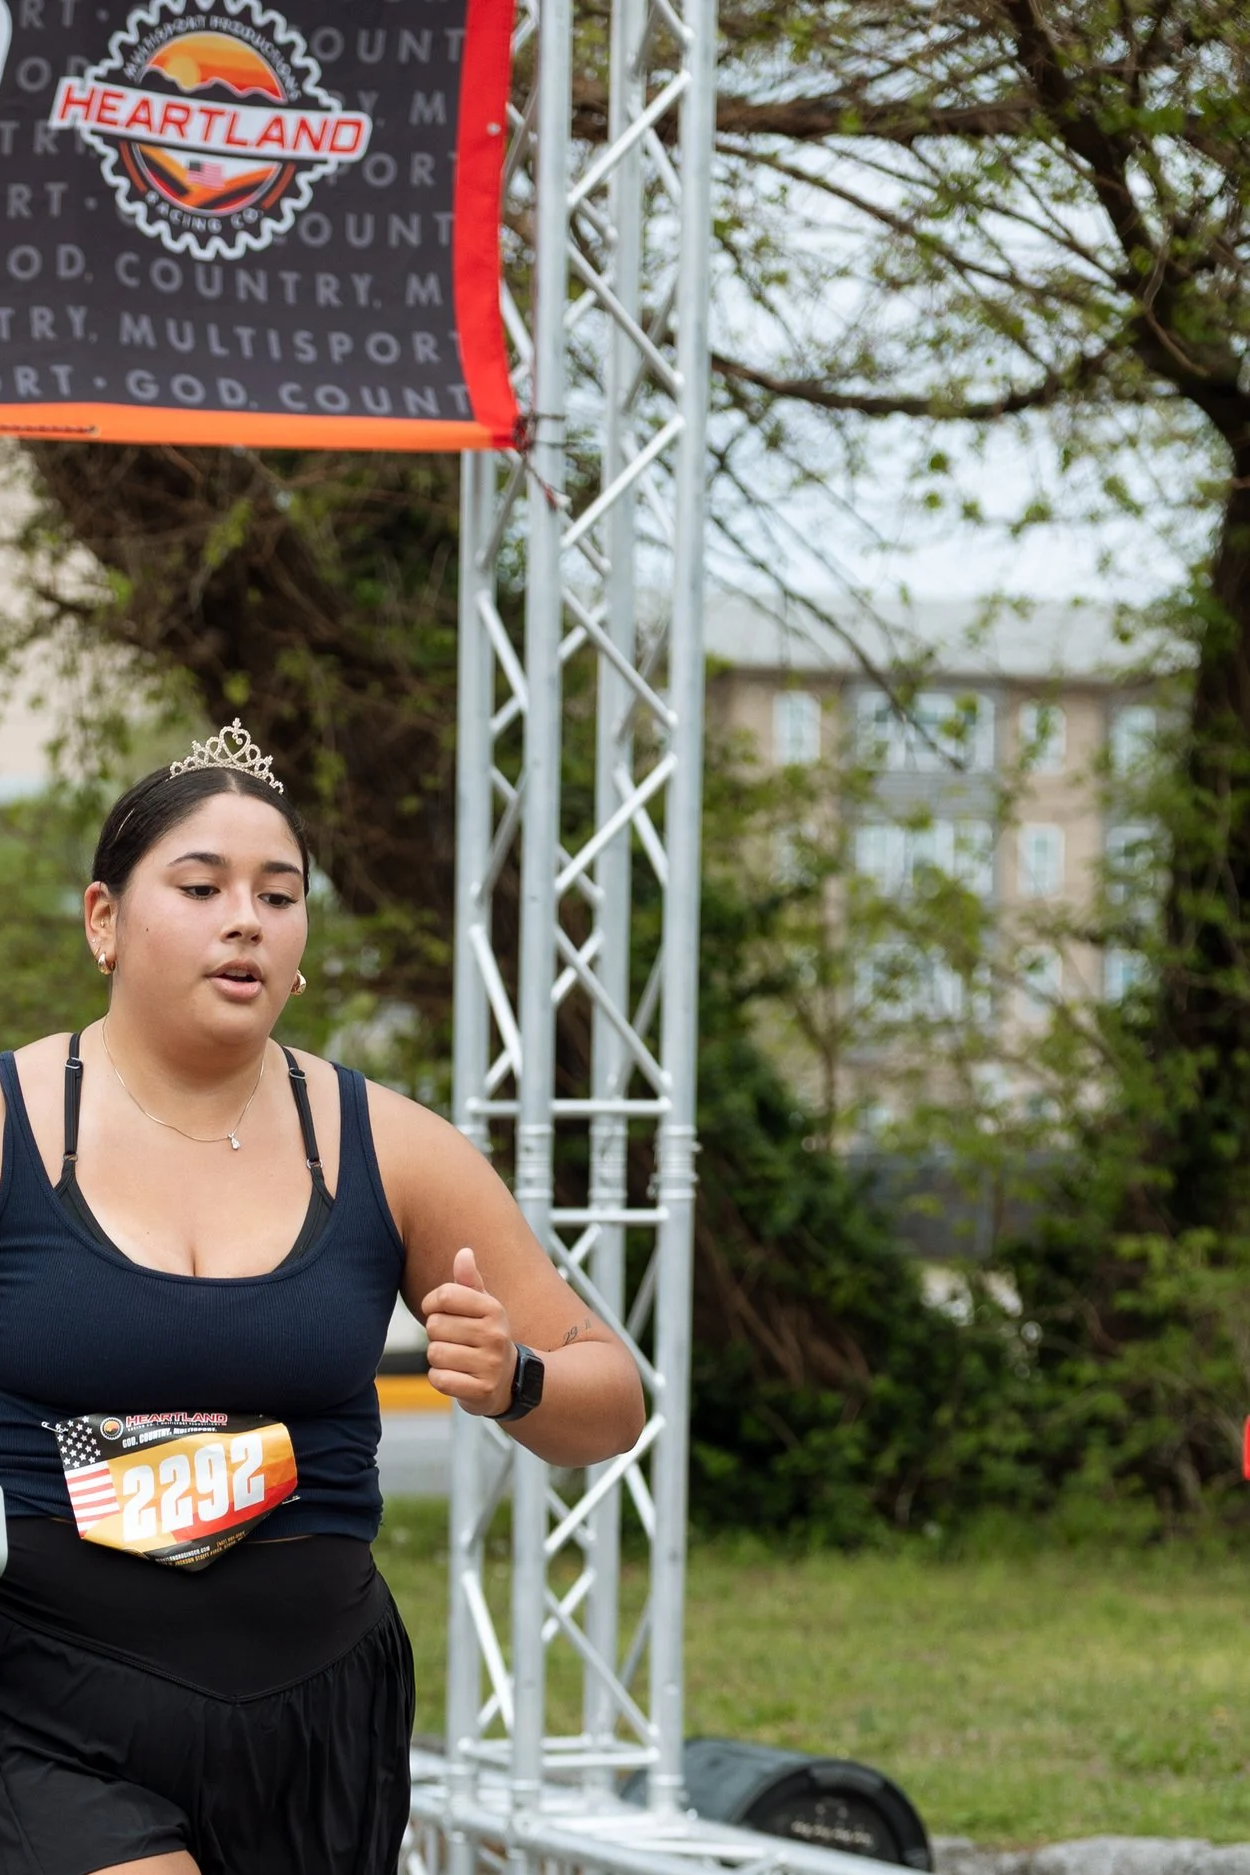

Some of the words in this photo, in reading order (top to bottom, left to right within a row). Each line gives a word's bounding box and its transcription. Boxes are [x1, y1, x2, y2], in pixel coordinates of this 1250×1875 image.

[57, 83, 365, 156] HEARTLAND
[125, 1411, 228, 1429] HEARTLAND
[122, 1432, 265, 1542] 2292
